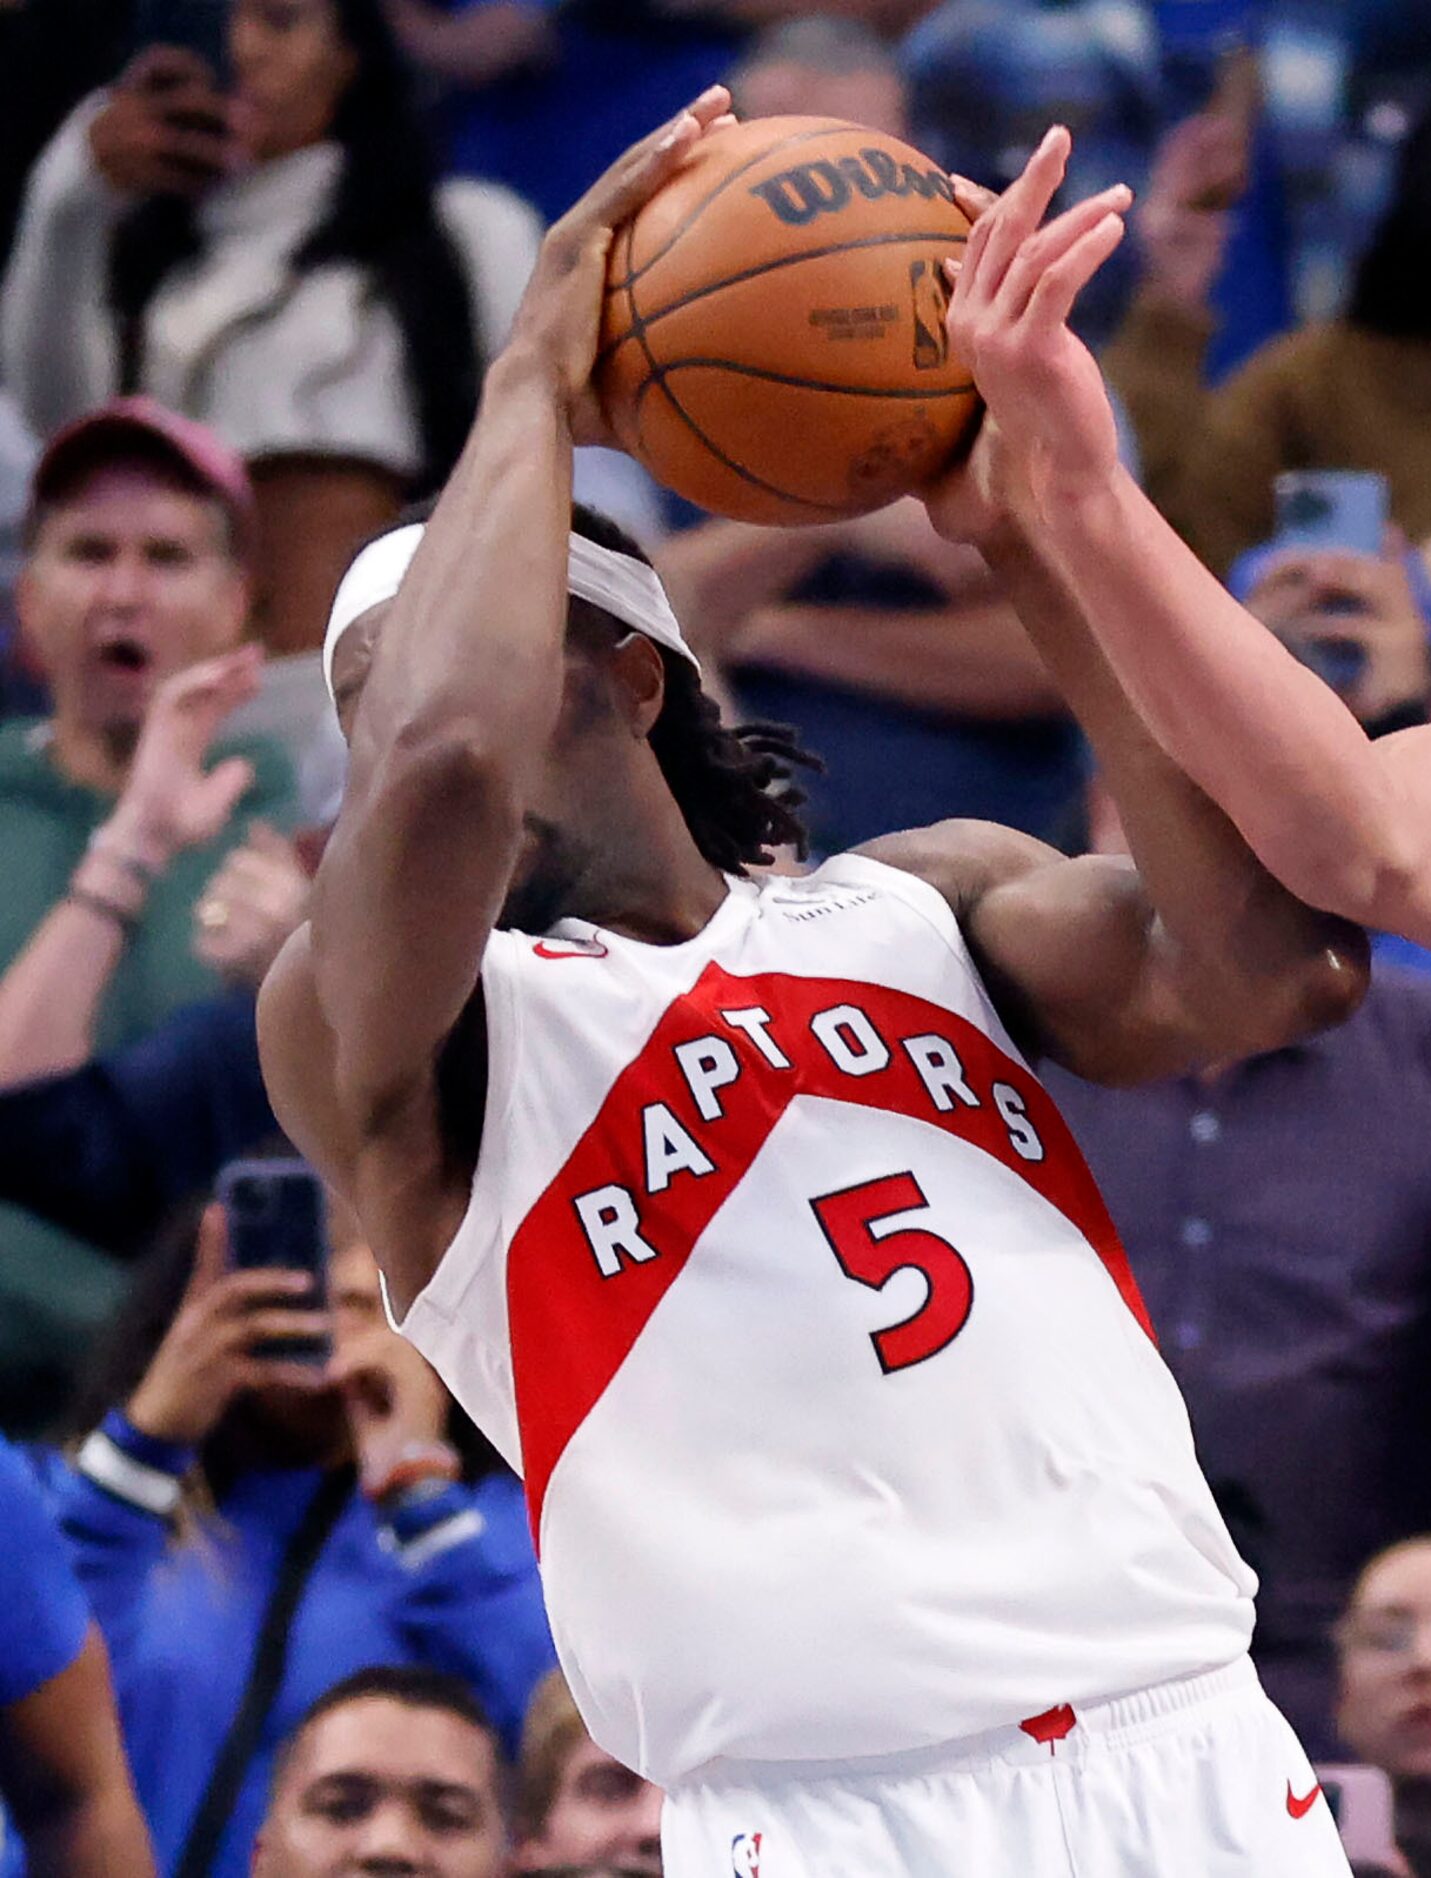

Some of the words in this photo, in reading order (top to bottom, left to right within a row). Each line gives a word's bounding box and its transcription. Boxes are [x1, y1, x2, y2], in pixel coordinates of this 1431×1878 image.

[751, 148, 955, 225] Wilso
[574, 1003, 1044, 1277] RAPTORS
[808, 1170, 973, 1375] 5
